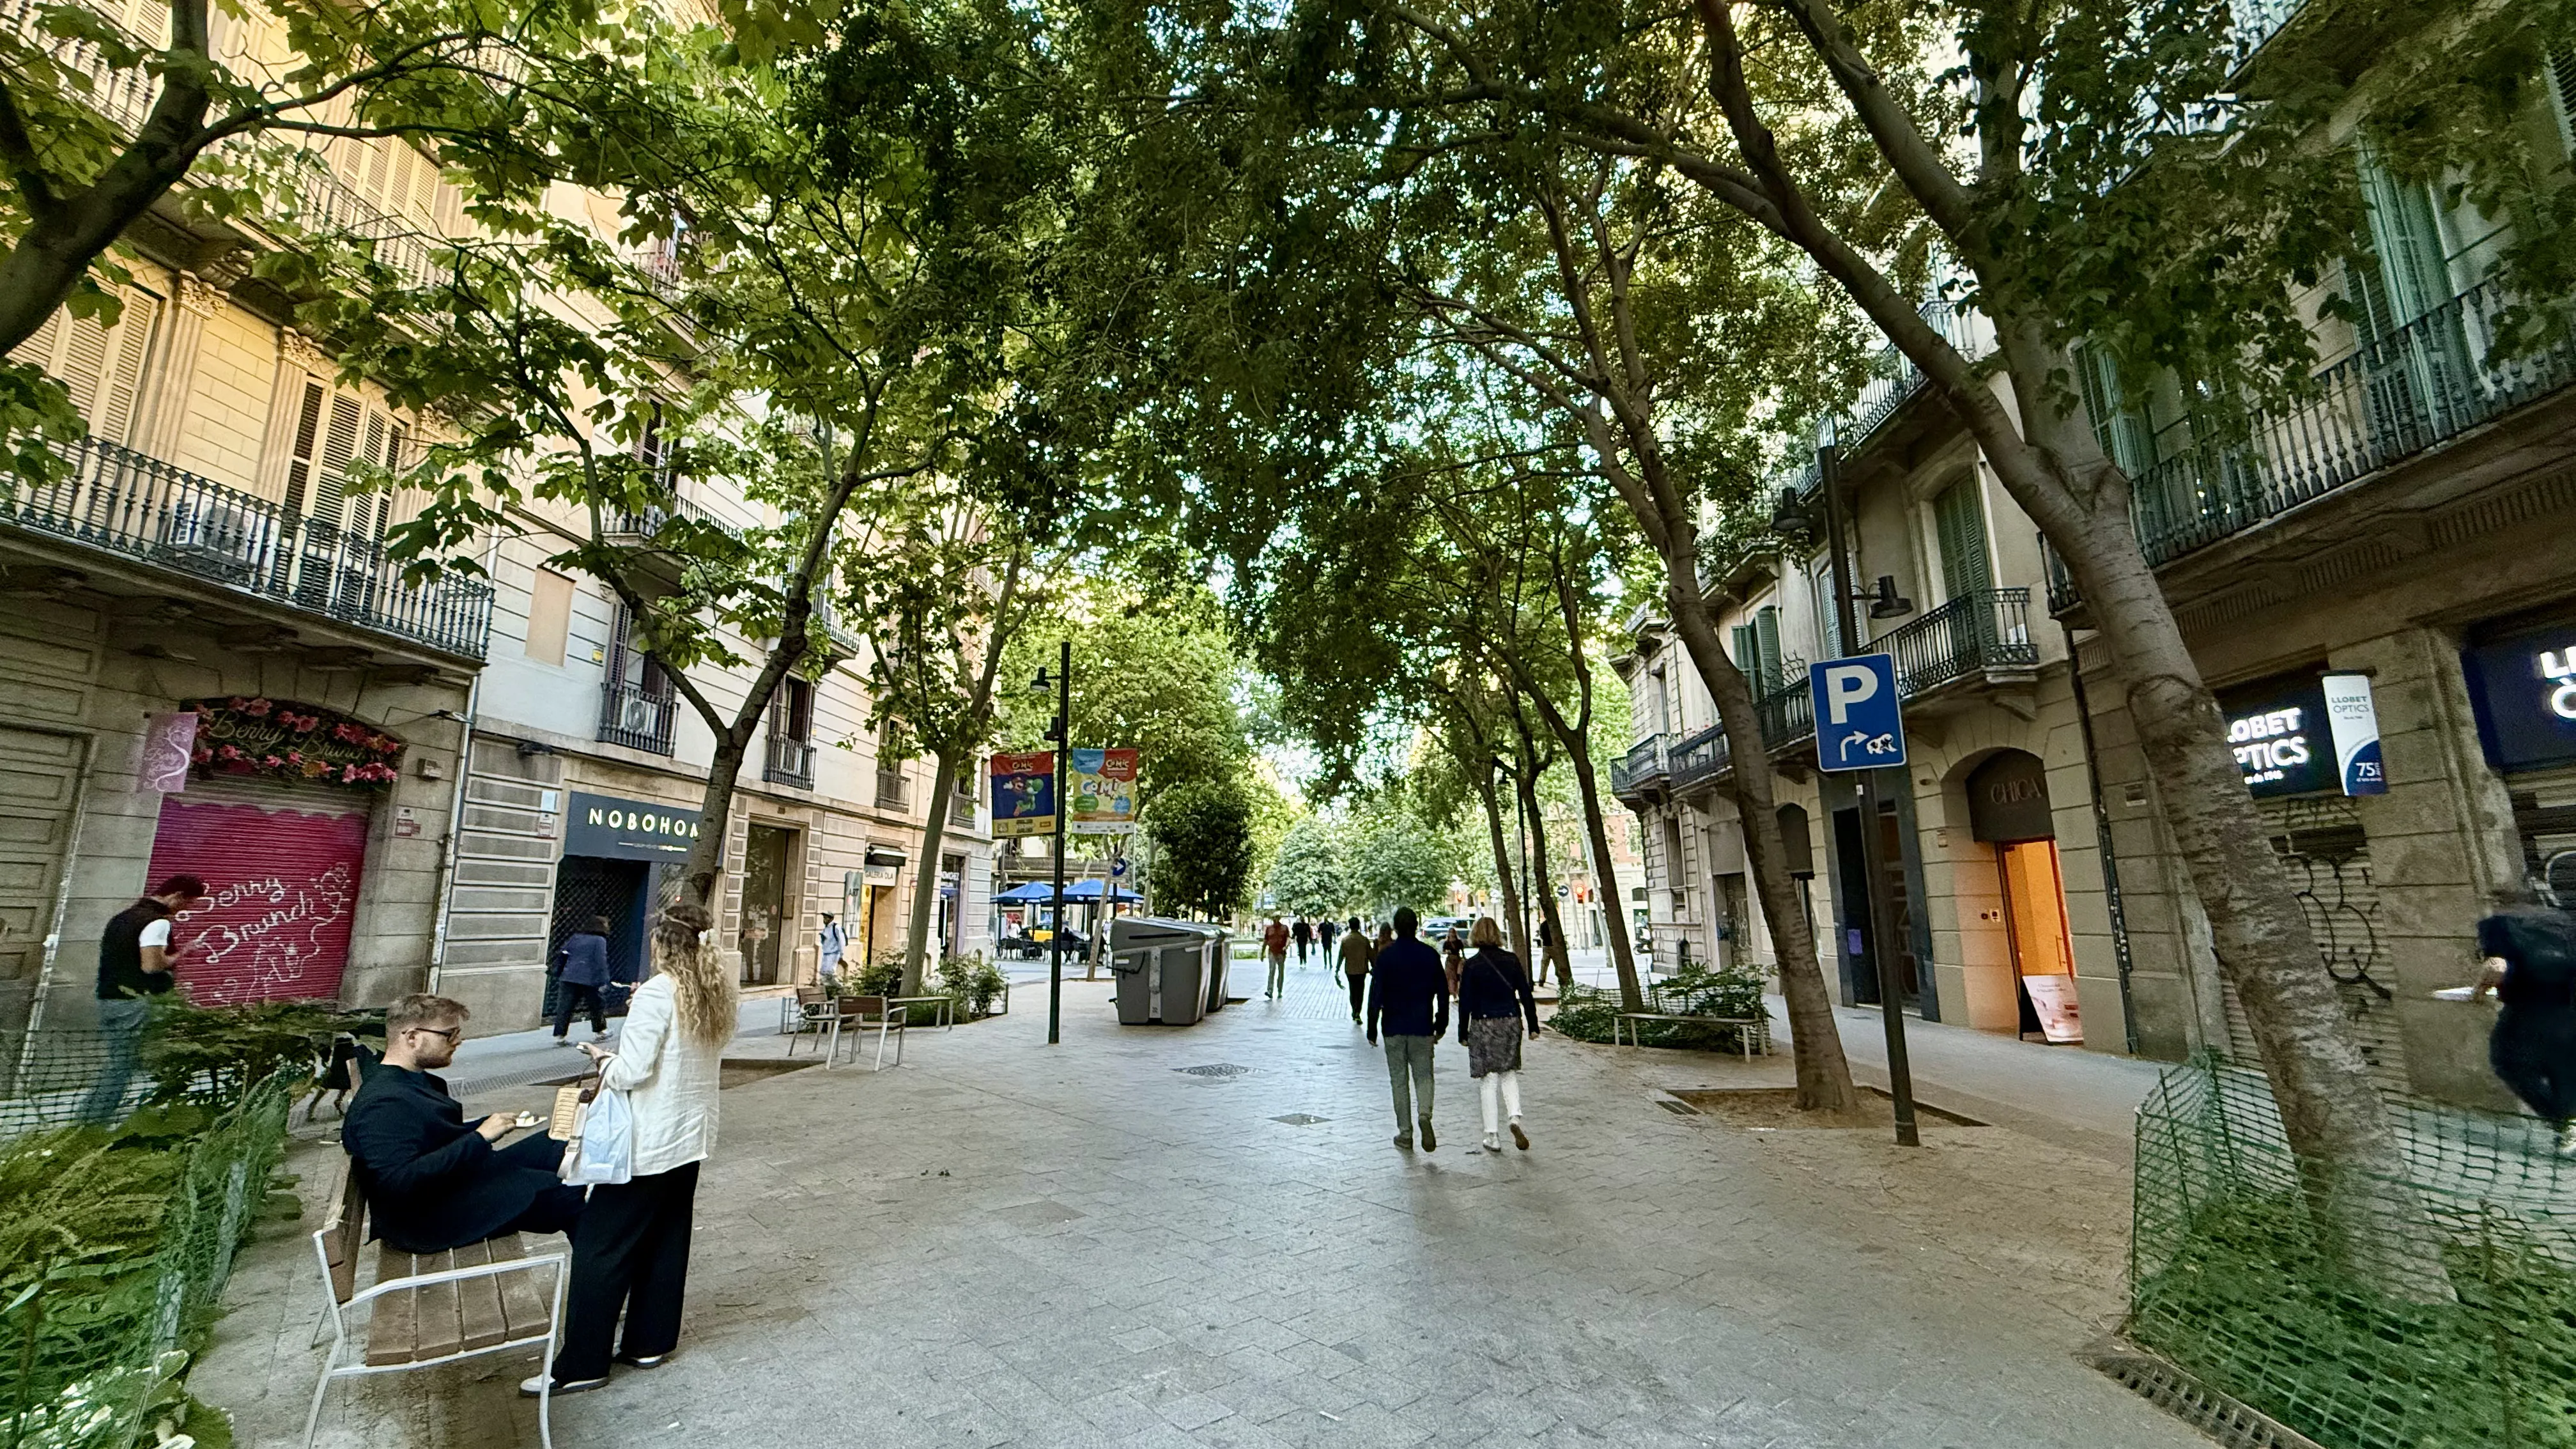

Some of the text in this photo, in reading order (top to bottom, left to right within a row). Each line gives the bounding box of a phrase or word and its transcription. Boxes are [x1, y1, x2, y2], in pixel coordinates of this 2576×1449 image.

[1826, 665, 1878, 724] P
[2333, 704, 2370, 713] OPTICS
[208, 708, 285, 750] Berry
[2227, 708, 2301, 743] OBET
[2233, 736, 2309, 770] PTICS
[2356, 763, 2375, 777] 75
[1991, 777, 2042, 805] CHICA
[194, 891, 314, 963] Brunch
